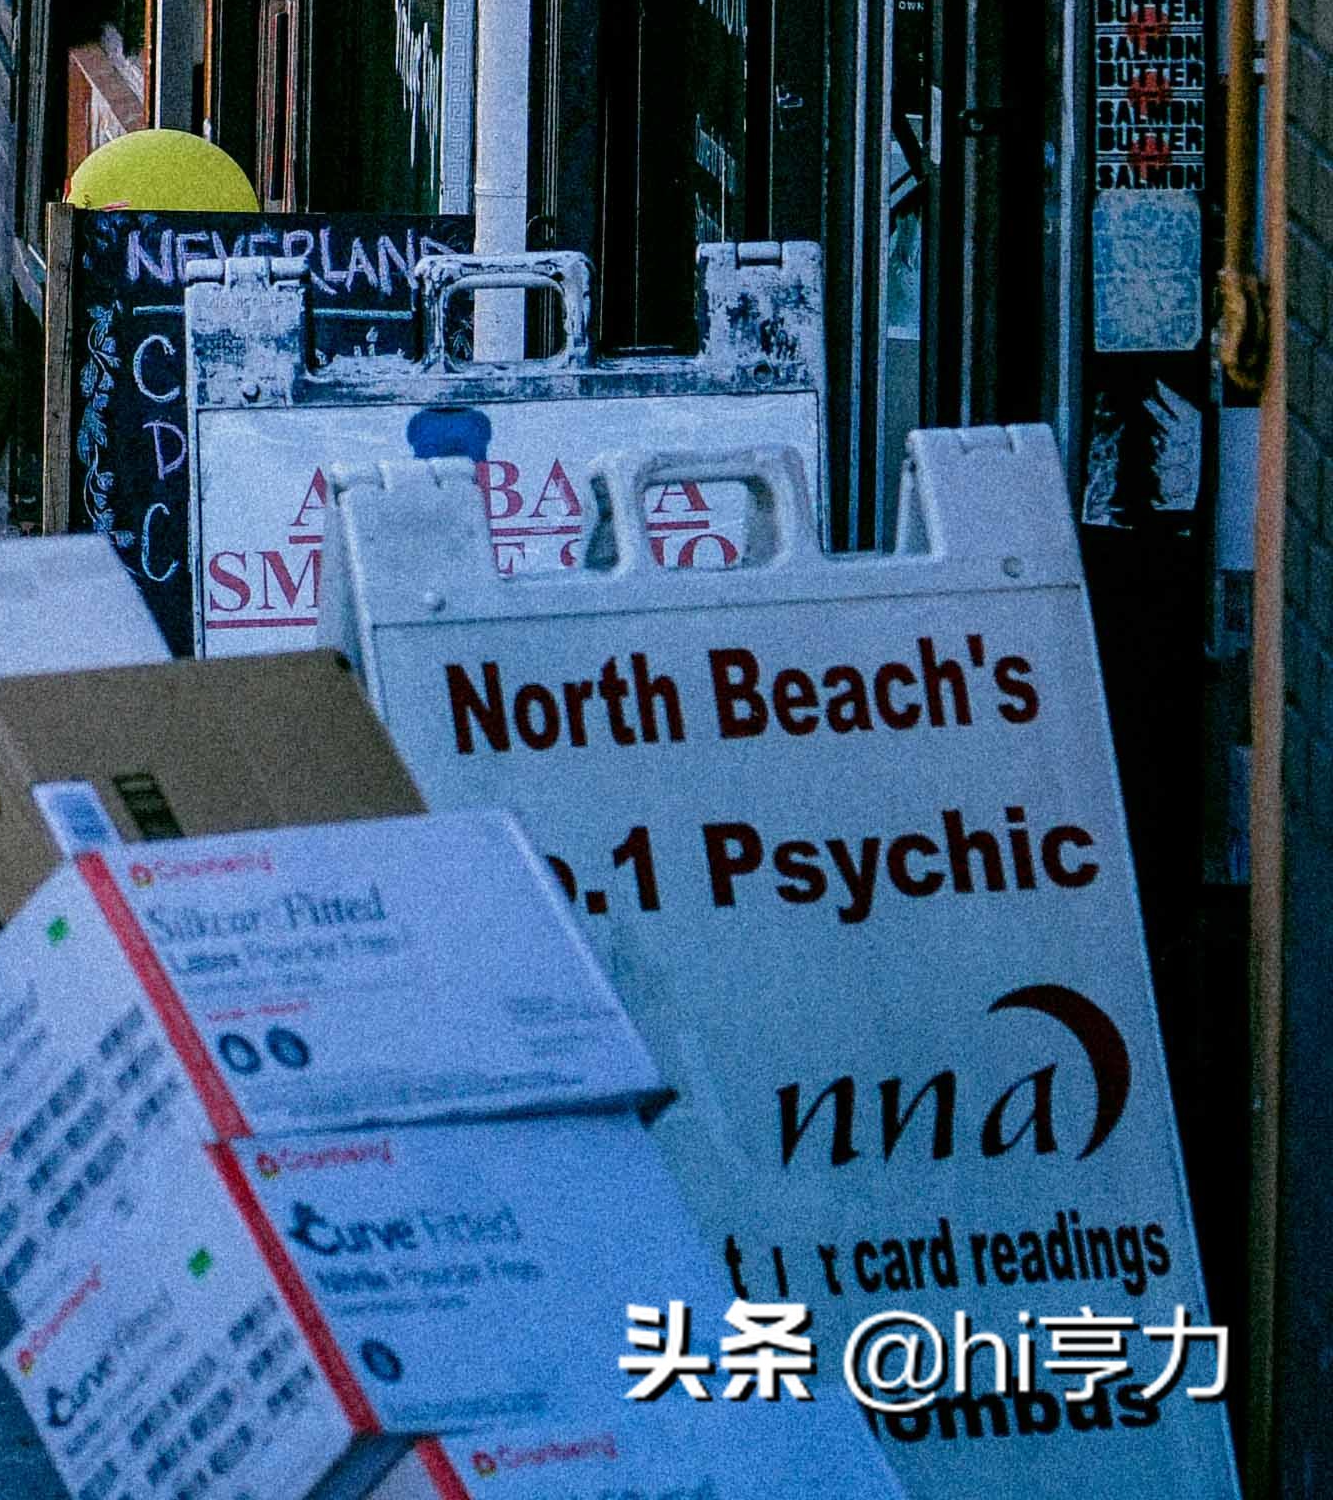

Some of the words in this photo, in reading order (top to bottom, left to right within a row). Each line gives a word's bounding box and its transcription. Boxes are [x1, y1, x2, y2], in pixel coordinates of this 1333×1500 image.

[444, 651, 685, 754] North
[710, 636, 1039, 750] Beach's
[704, 805, 1099, 924] Psychic
[853, 1216, 959, 1293] card
[969, 1209, 1171, 1297] readings
